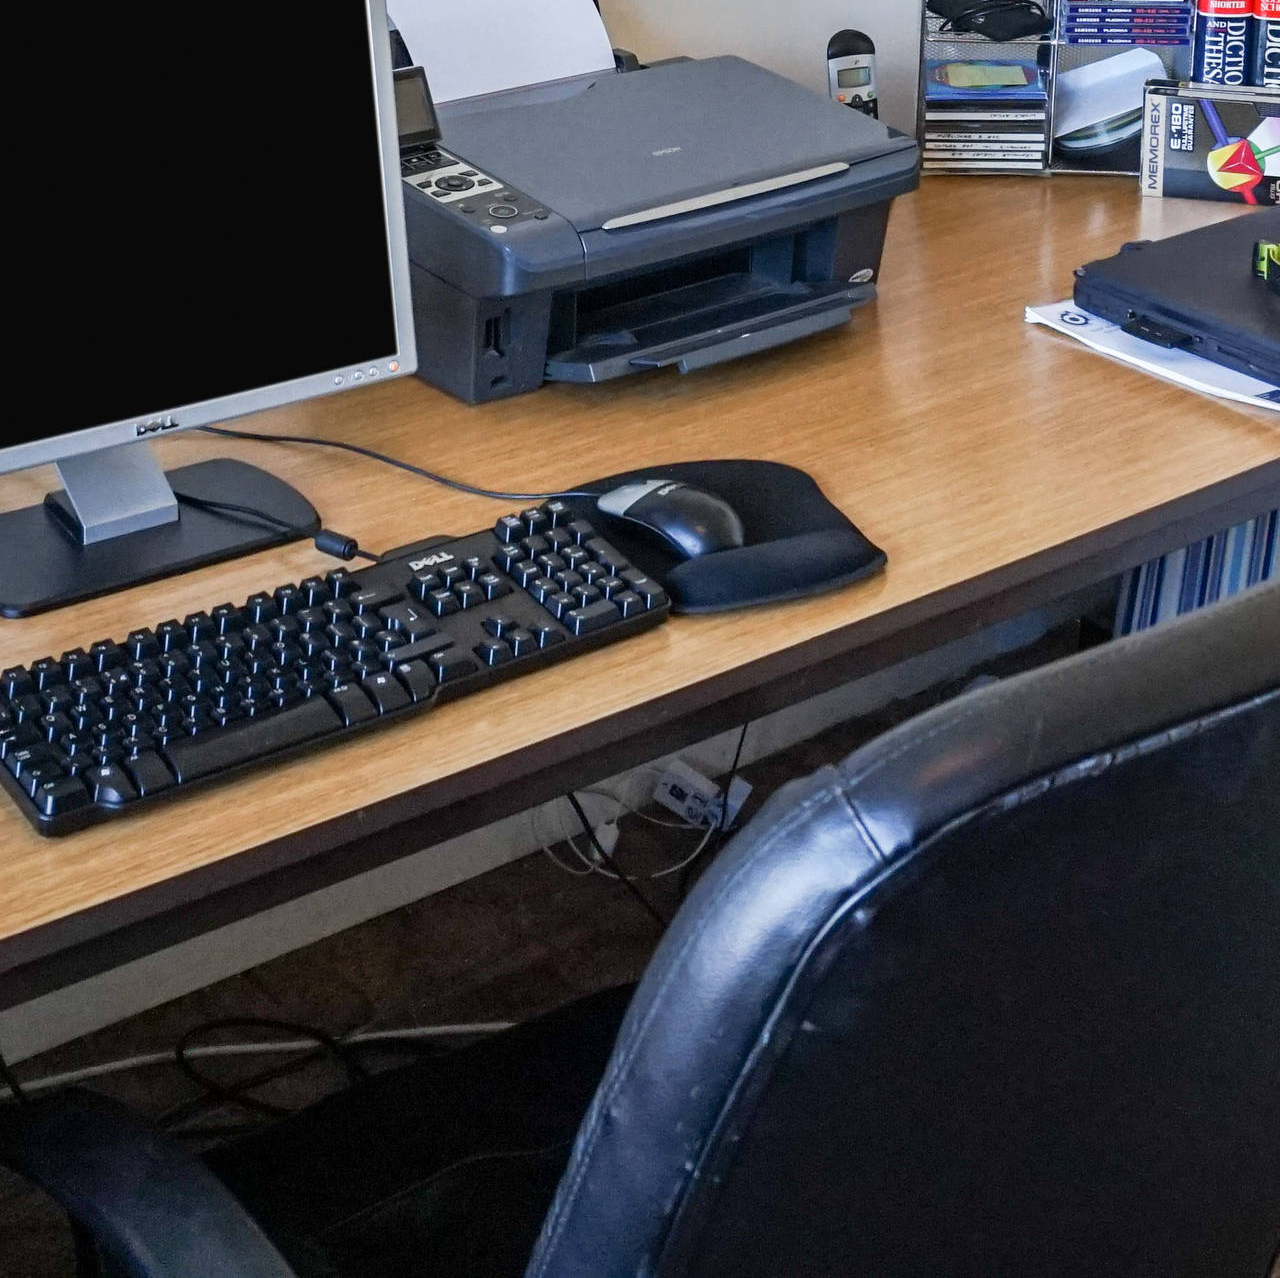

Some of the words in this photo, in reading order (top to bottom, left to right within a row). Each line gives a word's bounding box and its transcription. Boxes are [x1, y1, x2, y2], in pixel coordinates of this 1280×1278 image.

[1209, 1, 1246, 9] SHORTER
[1207, 20, 1227, 28] AND
[1147, 102, 1161, 190] MEMOREX
[135, 414, 179, 437] DELL
[408, 550, 456, 573] DELL
